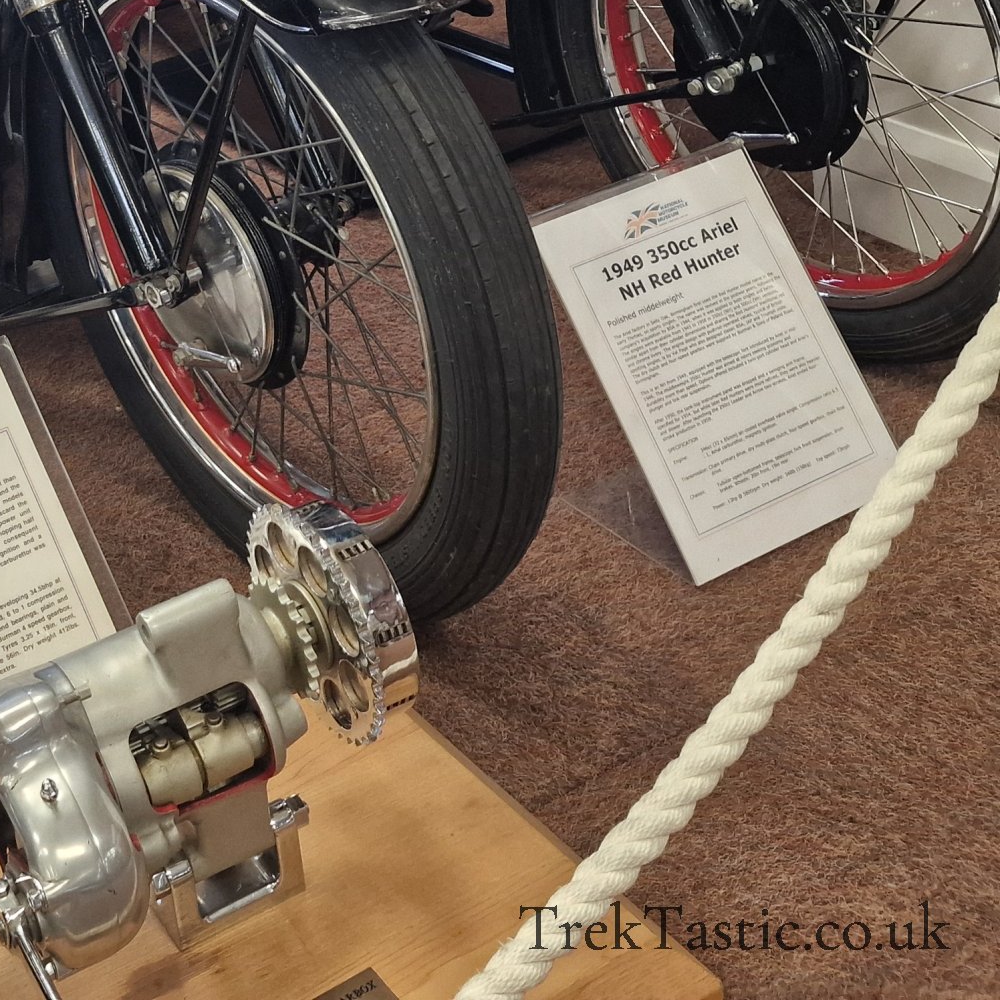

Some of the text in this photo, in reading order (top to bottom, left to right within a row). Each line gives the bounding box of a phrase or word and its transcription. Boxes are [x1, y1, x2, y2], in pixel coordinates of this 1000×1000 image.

[602, 255, 644, 282] 1949
[647, 236, 698, 263] 350cc
[701, 217, 738, 243] Ariel
[619, 244, 740, 300] NH Red Hunter
[607, 293, 684, 328] Polished middelweight
[2, 475, 16, 483] than
[27, 615, 45, 628] speed
